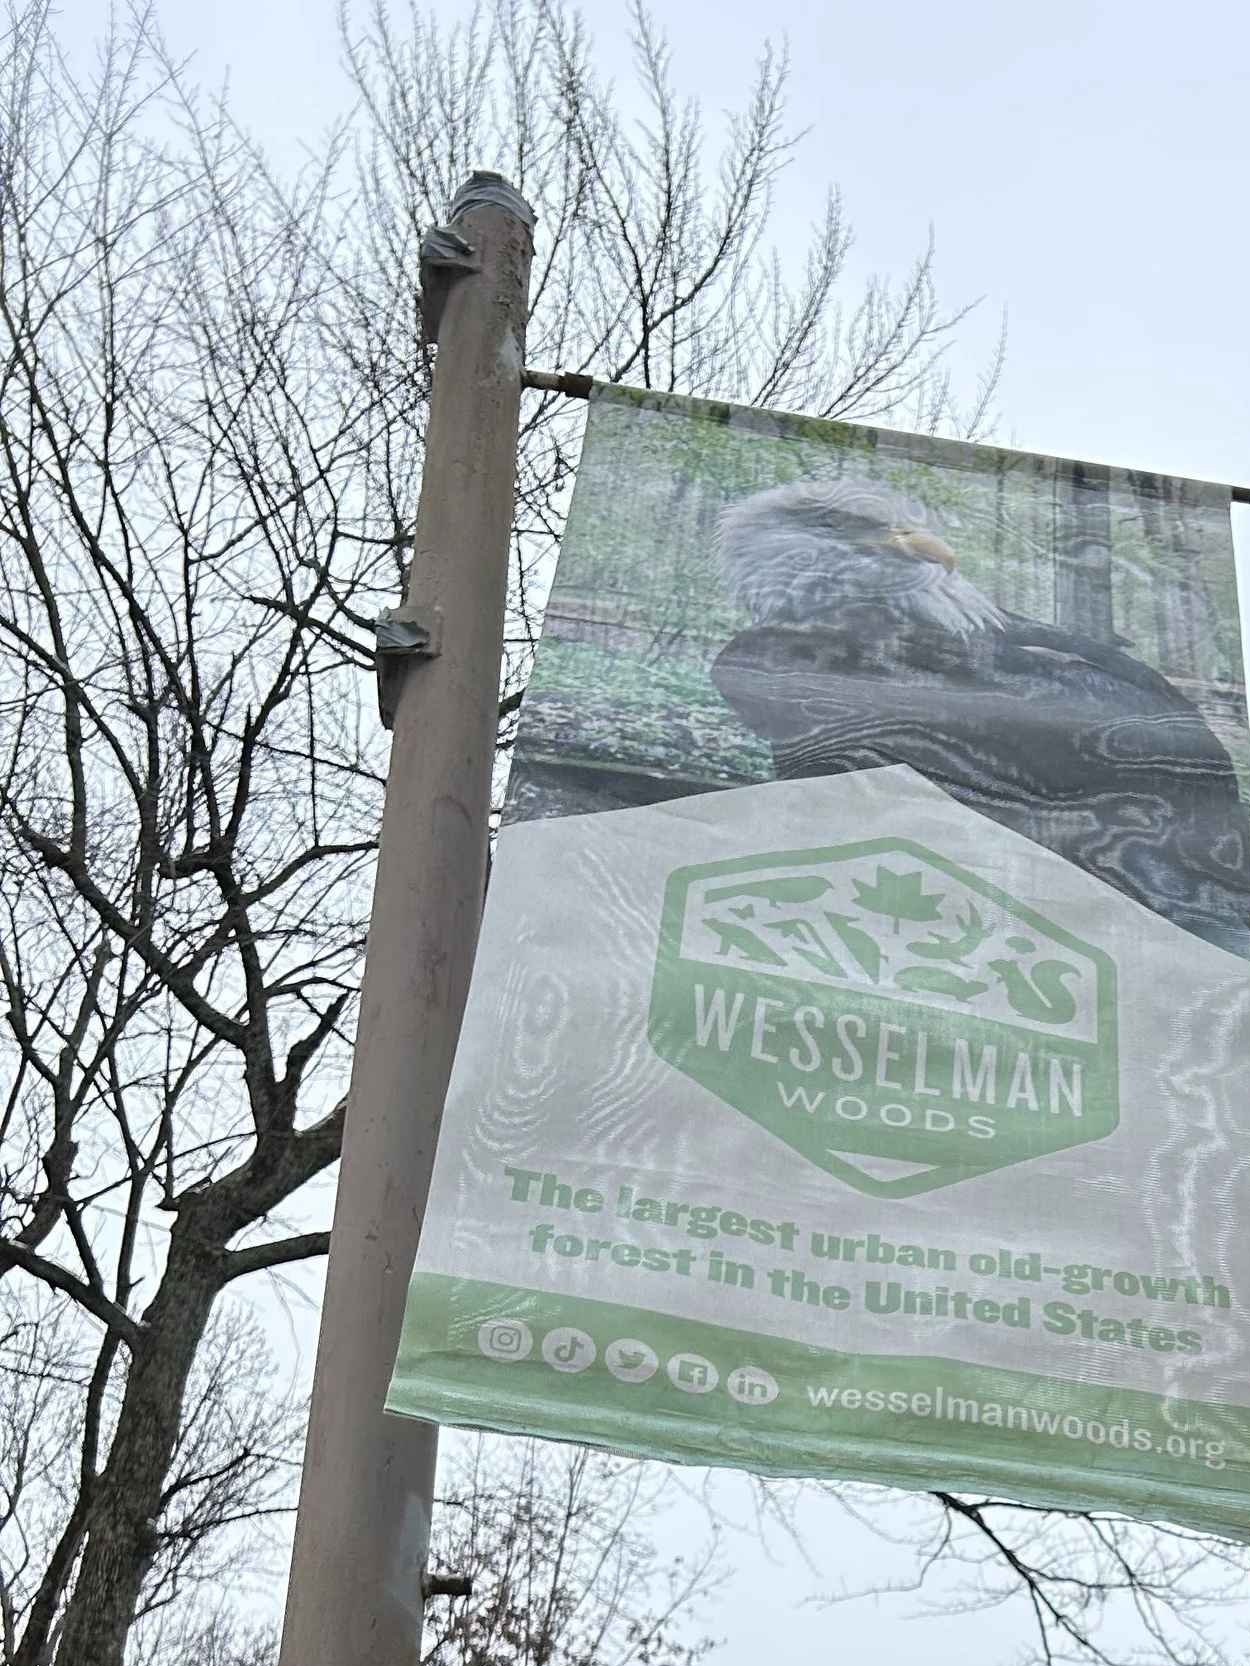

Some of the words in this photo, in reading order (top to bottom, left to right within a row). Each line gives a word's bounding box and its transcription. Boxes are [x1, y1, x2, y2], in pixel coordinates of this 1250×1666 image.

[694, 984, 1083, 1116] WESSELMAN
[777, 1082, 996, 1138] WOODS
[504, 1167, 603, 1213] The
[617, 1187, 799, 1250] largest
[811, 1232, 956, 1271] urban
[969, 1248, 1230, 1309] old-growth
[529, 1223, 696, 1276] forest
[707, 1251, 755, 1289] in
[767, 1269, 851, 1310] the
[865, 1281, 1031, 1329] United
[1042, 1301, 1201, 1355] States
[806, 1385, 1227, 1470] wesselmanwoods.org
